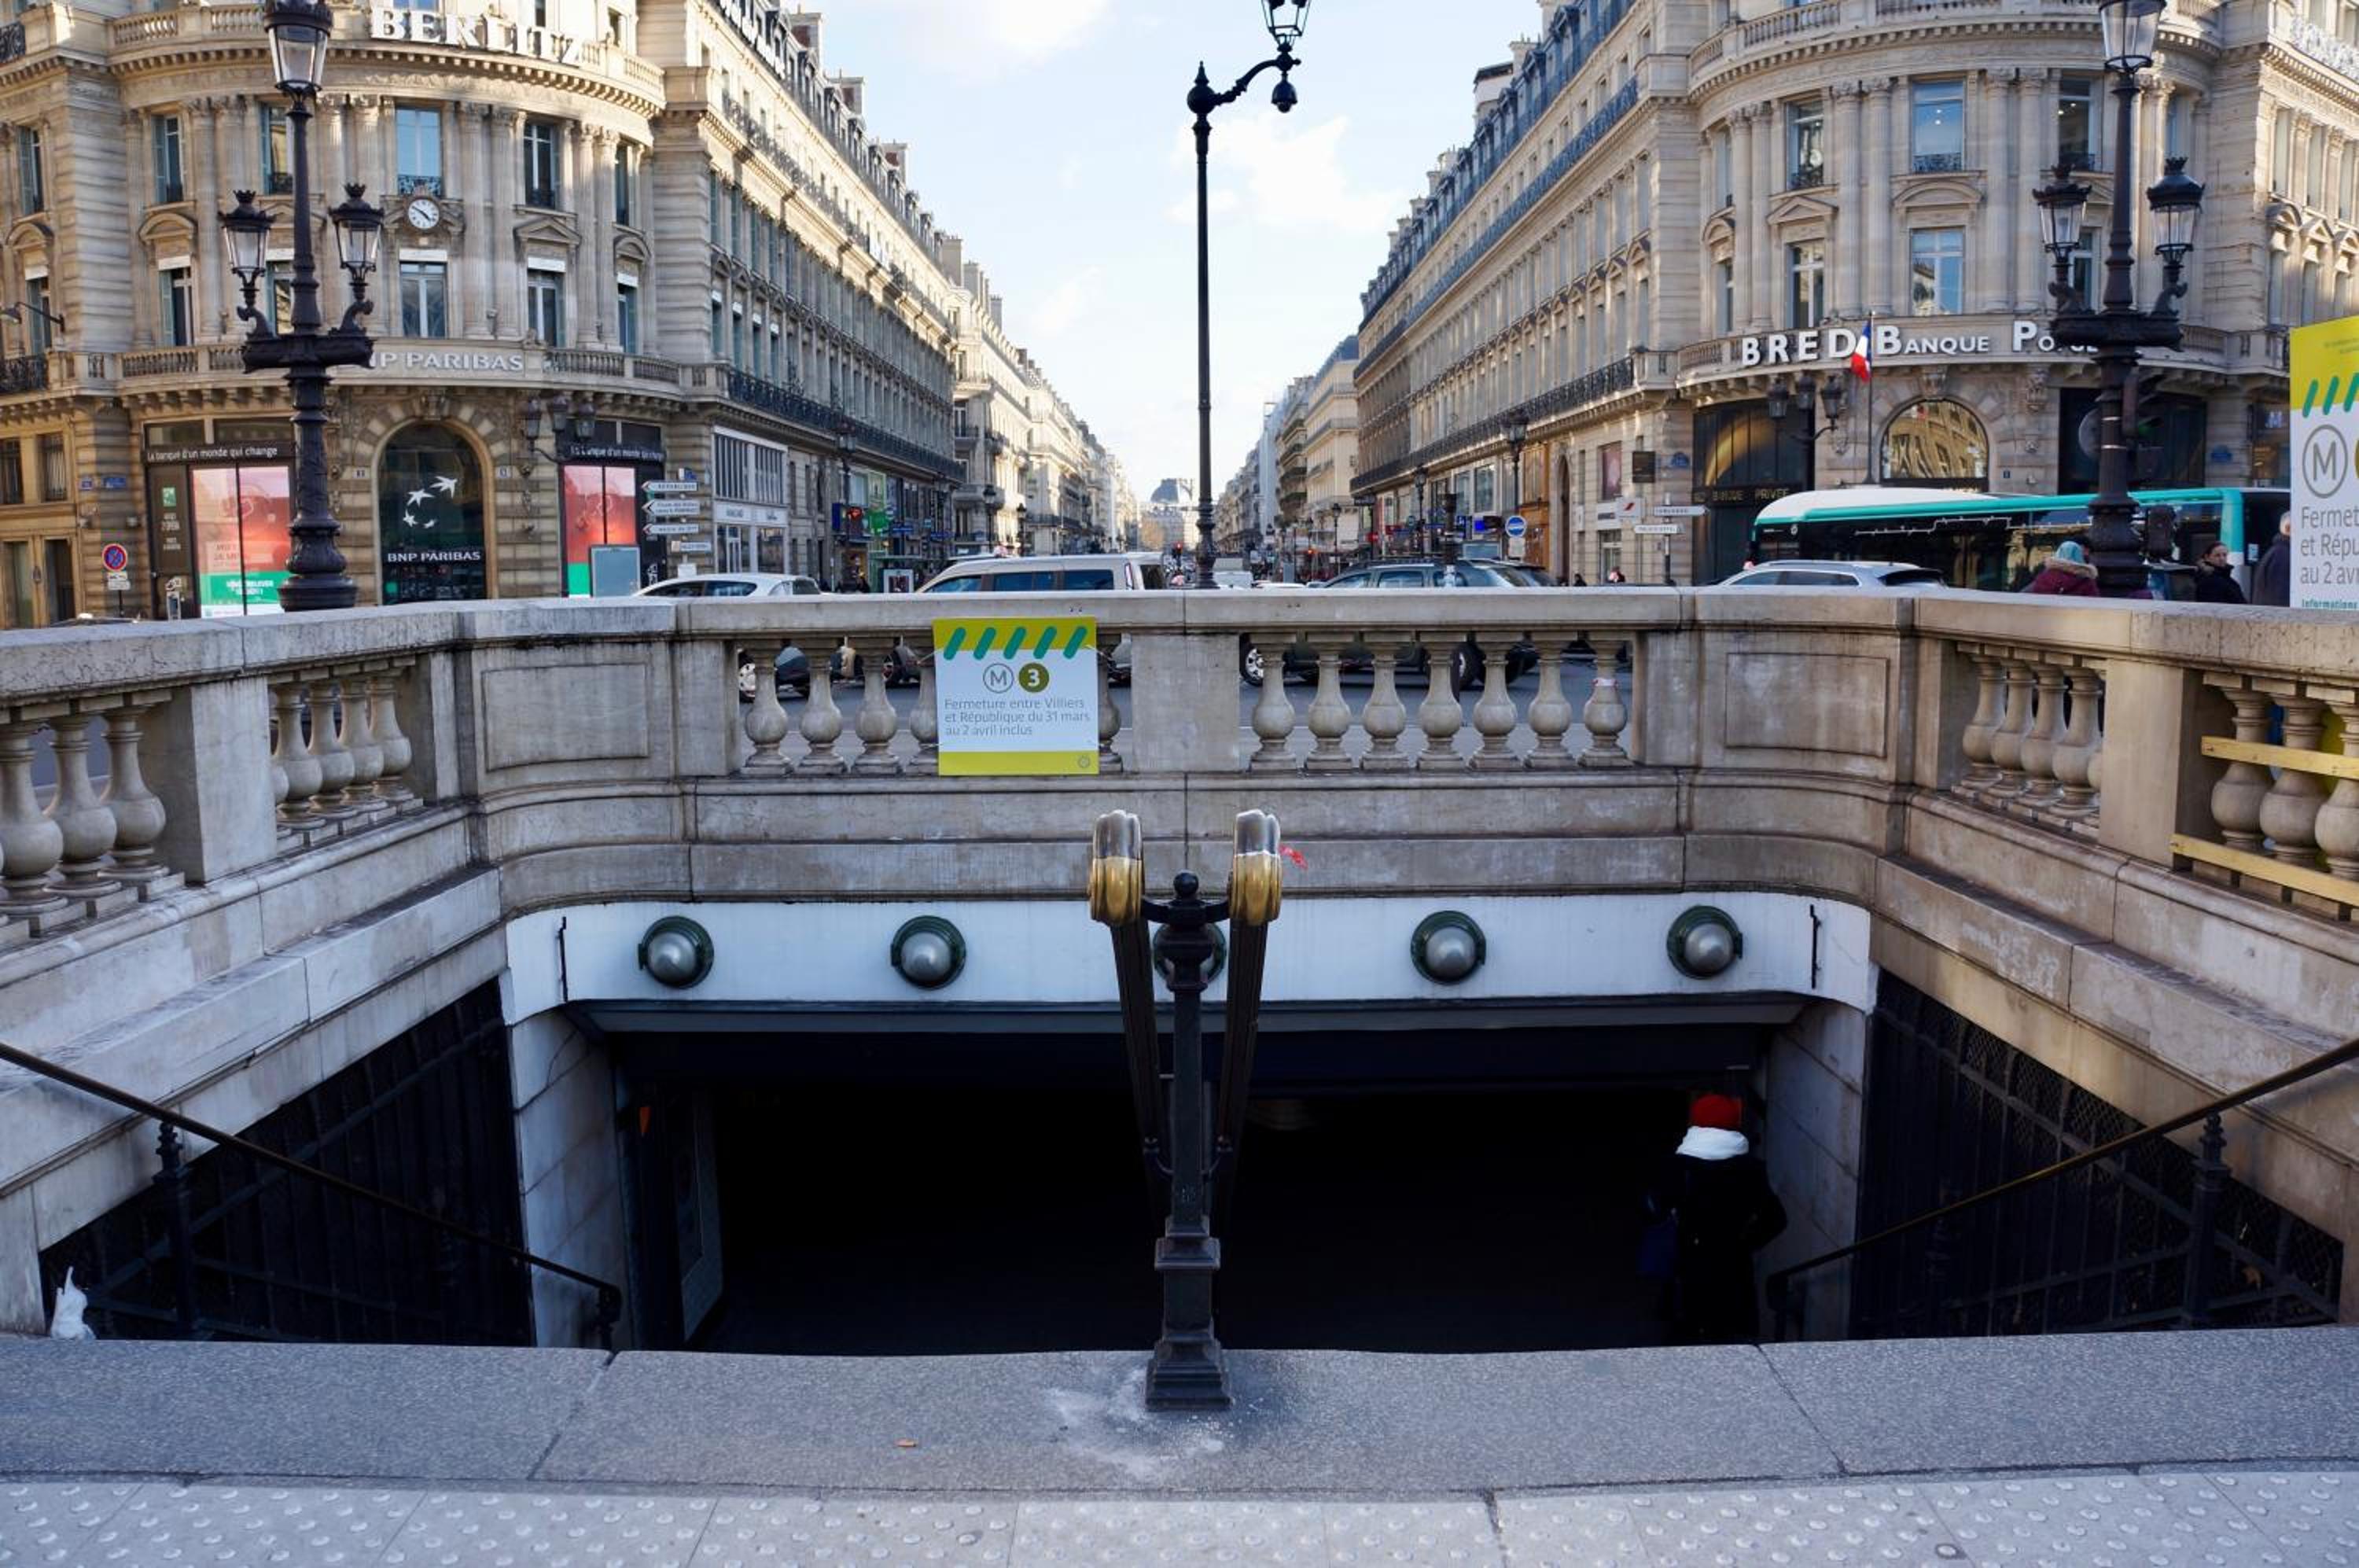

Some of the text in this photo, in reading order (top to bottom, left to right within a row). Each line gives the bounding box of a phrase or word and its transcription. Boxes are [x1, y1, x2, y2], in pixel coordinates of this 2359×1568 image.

[370, 7, 583, 68] BERLITZ
[1742, 329, 1857, 366] BRED
[1877, 325, 1989, 355] BANQUE
[406, 353, 524, 371] PARIBAS
[2301, 536, 2316, 556] et
[388, 551, 480, 562] BNP PARIBAS
[2301, 567, 2319, 584] au
[2323, 561, 2332, 584] 2
[1027, 669, 1040, 686] 3
[944, 698, 1084, 709] Fermeture entre Villiers
[944, 710, 1090, 725] et République du 31 mars
[944, 723, 1032, 735] au 2 avril inclus
